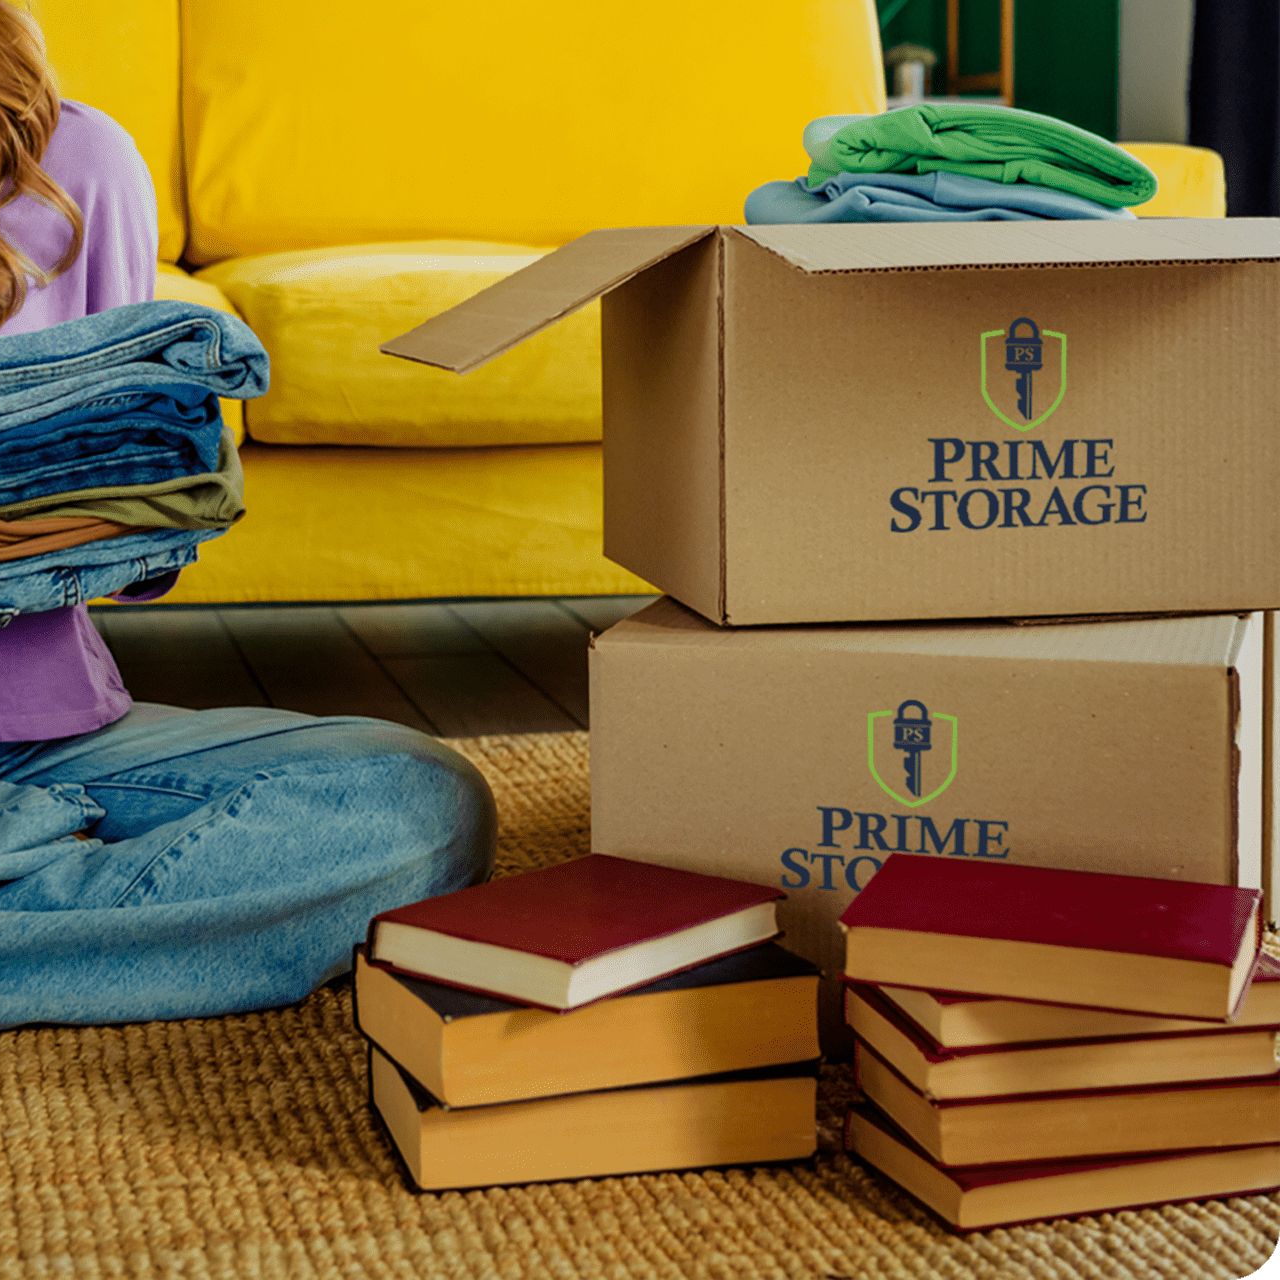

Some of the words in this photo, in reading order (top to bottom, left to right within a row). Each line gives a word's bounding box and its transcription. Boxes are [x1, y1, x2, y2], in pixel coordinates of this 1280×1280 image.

[1014, 347, 1035, 362] PS
[927, 437, 1115, 483] PRIME
[889, 484, 1148, 533] STORAGE
[902, 727, 924, 742] PS
[816, 805, 1010, 859] PRIME
